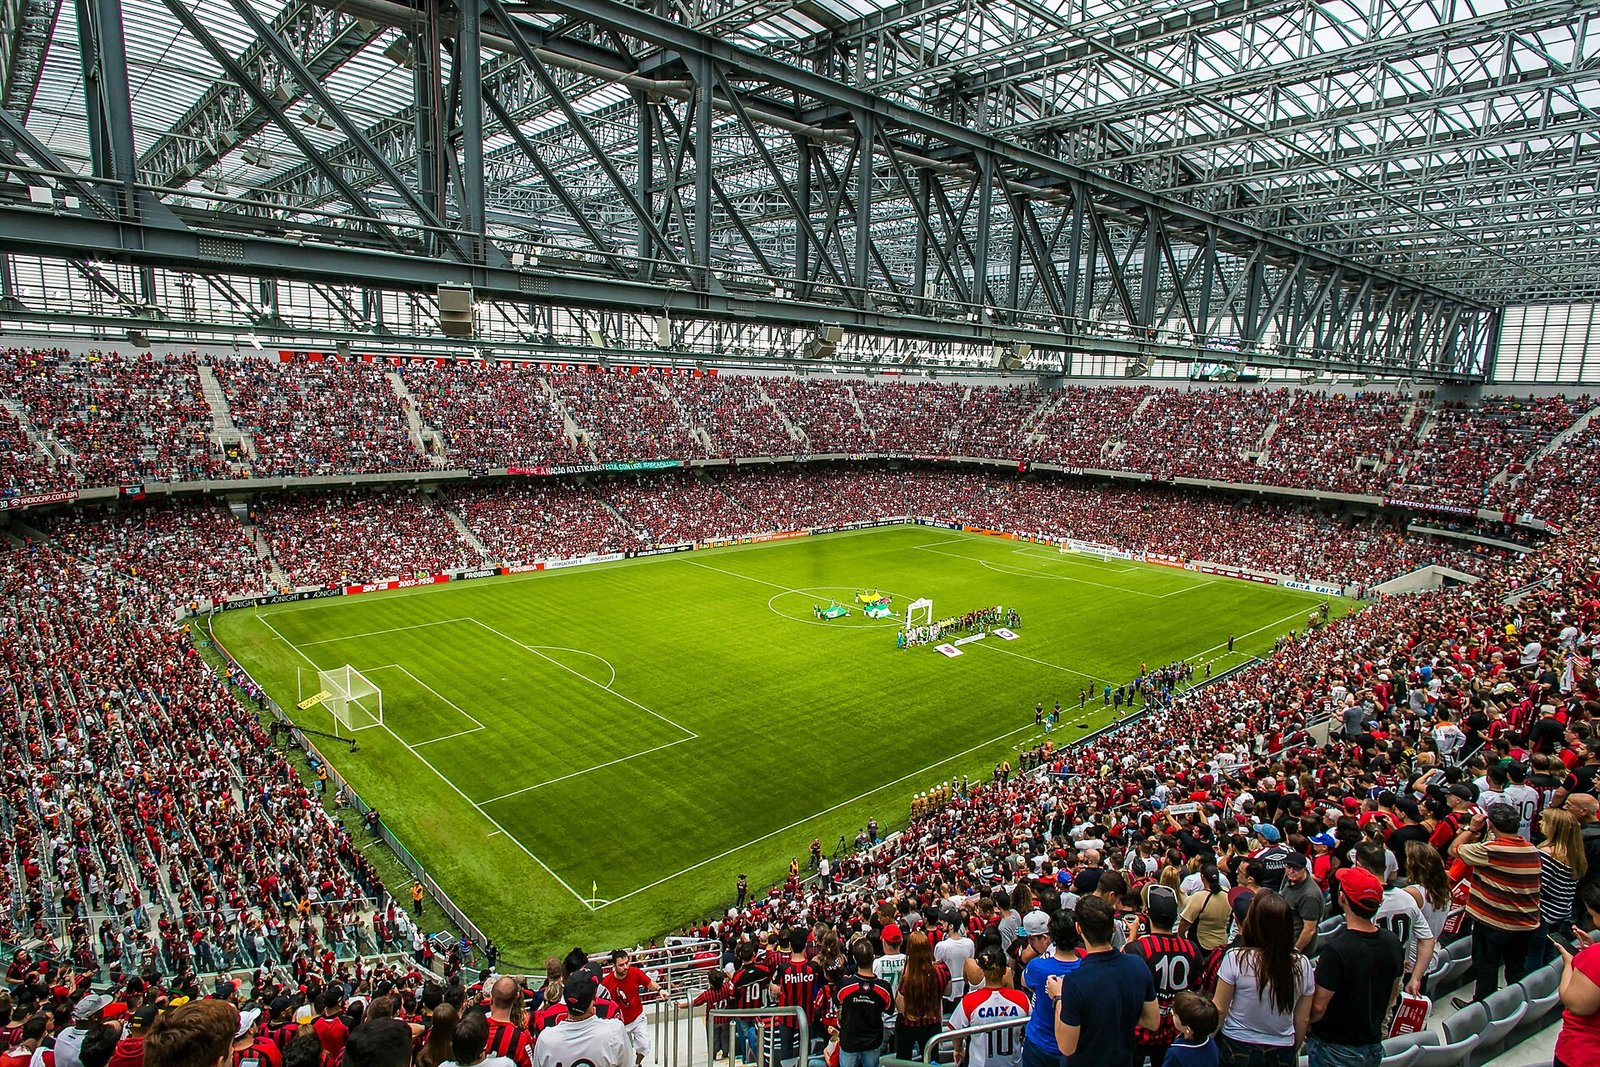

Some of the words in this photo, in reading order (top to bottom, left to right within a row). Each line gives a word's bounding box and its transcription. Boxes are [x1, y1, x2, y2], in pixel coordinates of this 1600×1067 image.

[1184, 563, 1198, 571] GOL
[464, 570, 495, 579] PROIBIDA
[363, 584, 377, 592] SKY
[1286, 581, 1310, 590] CAIXA
[1315, 586, 1341, 595] CAIXA
[784, 972, 814, 984] Philco
[1155, 954, 1190, 991] 10
[746, 983, 760, 1002] 10
[978, 1006, 1019, 1018] CAIXA
[986, 1027, 1013, 1058] 10
